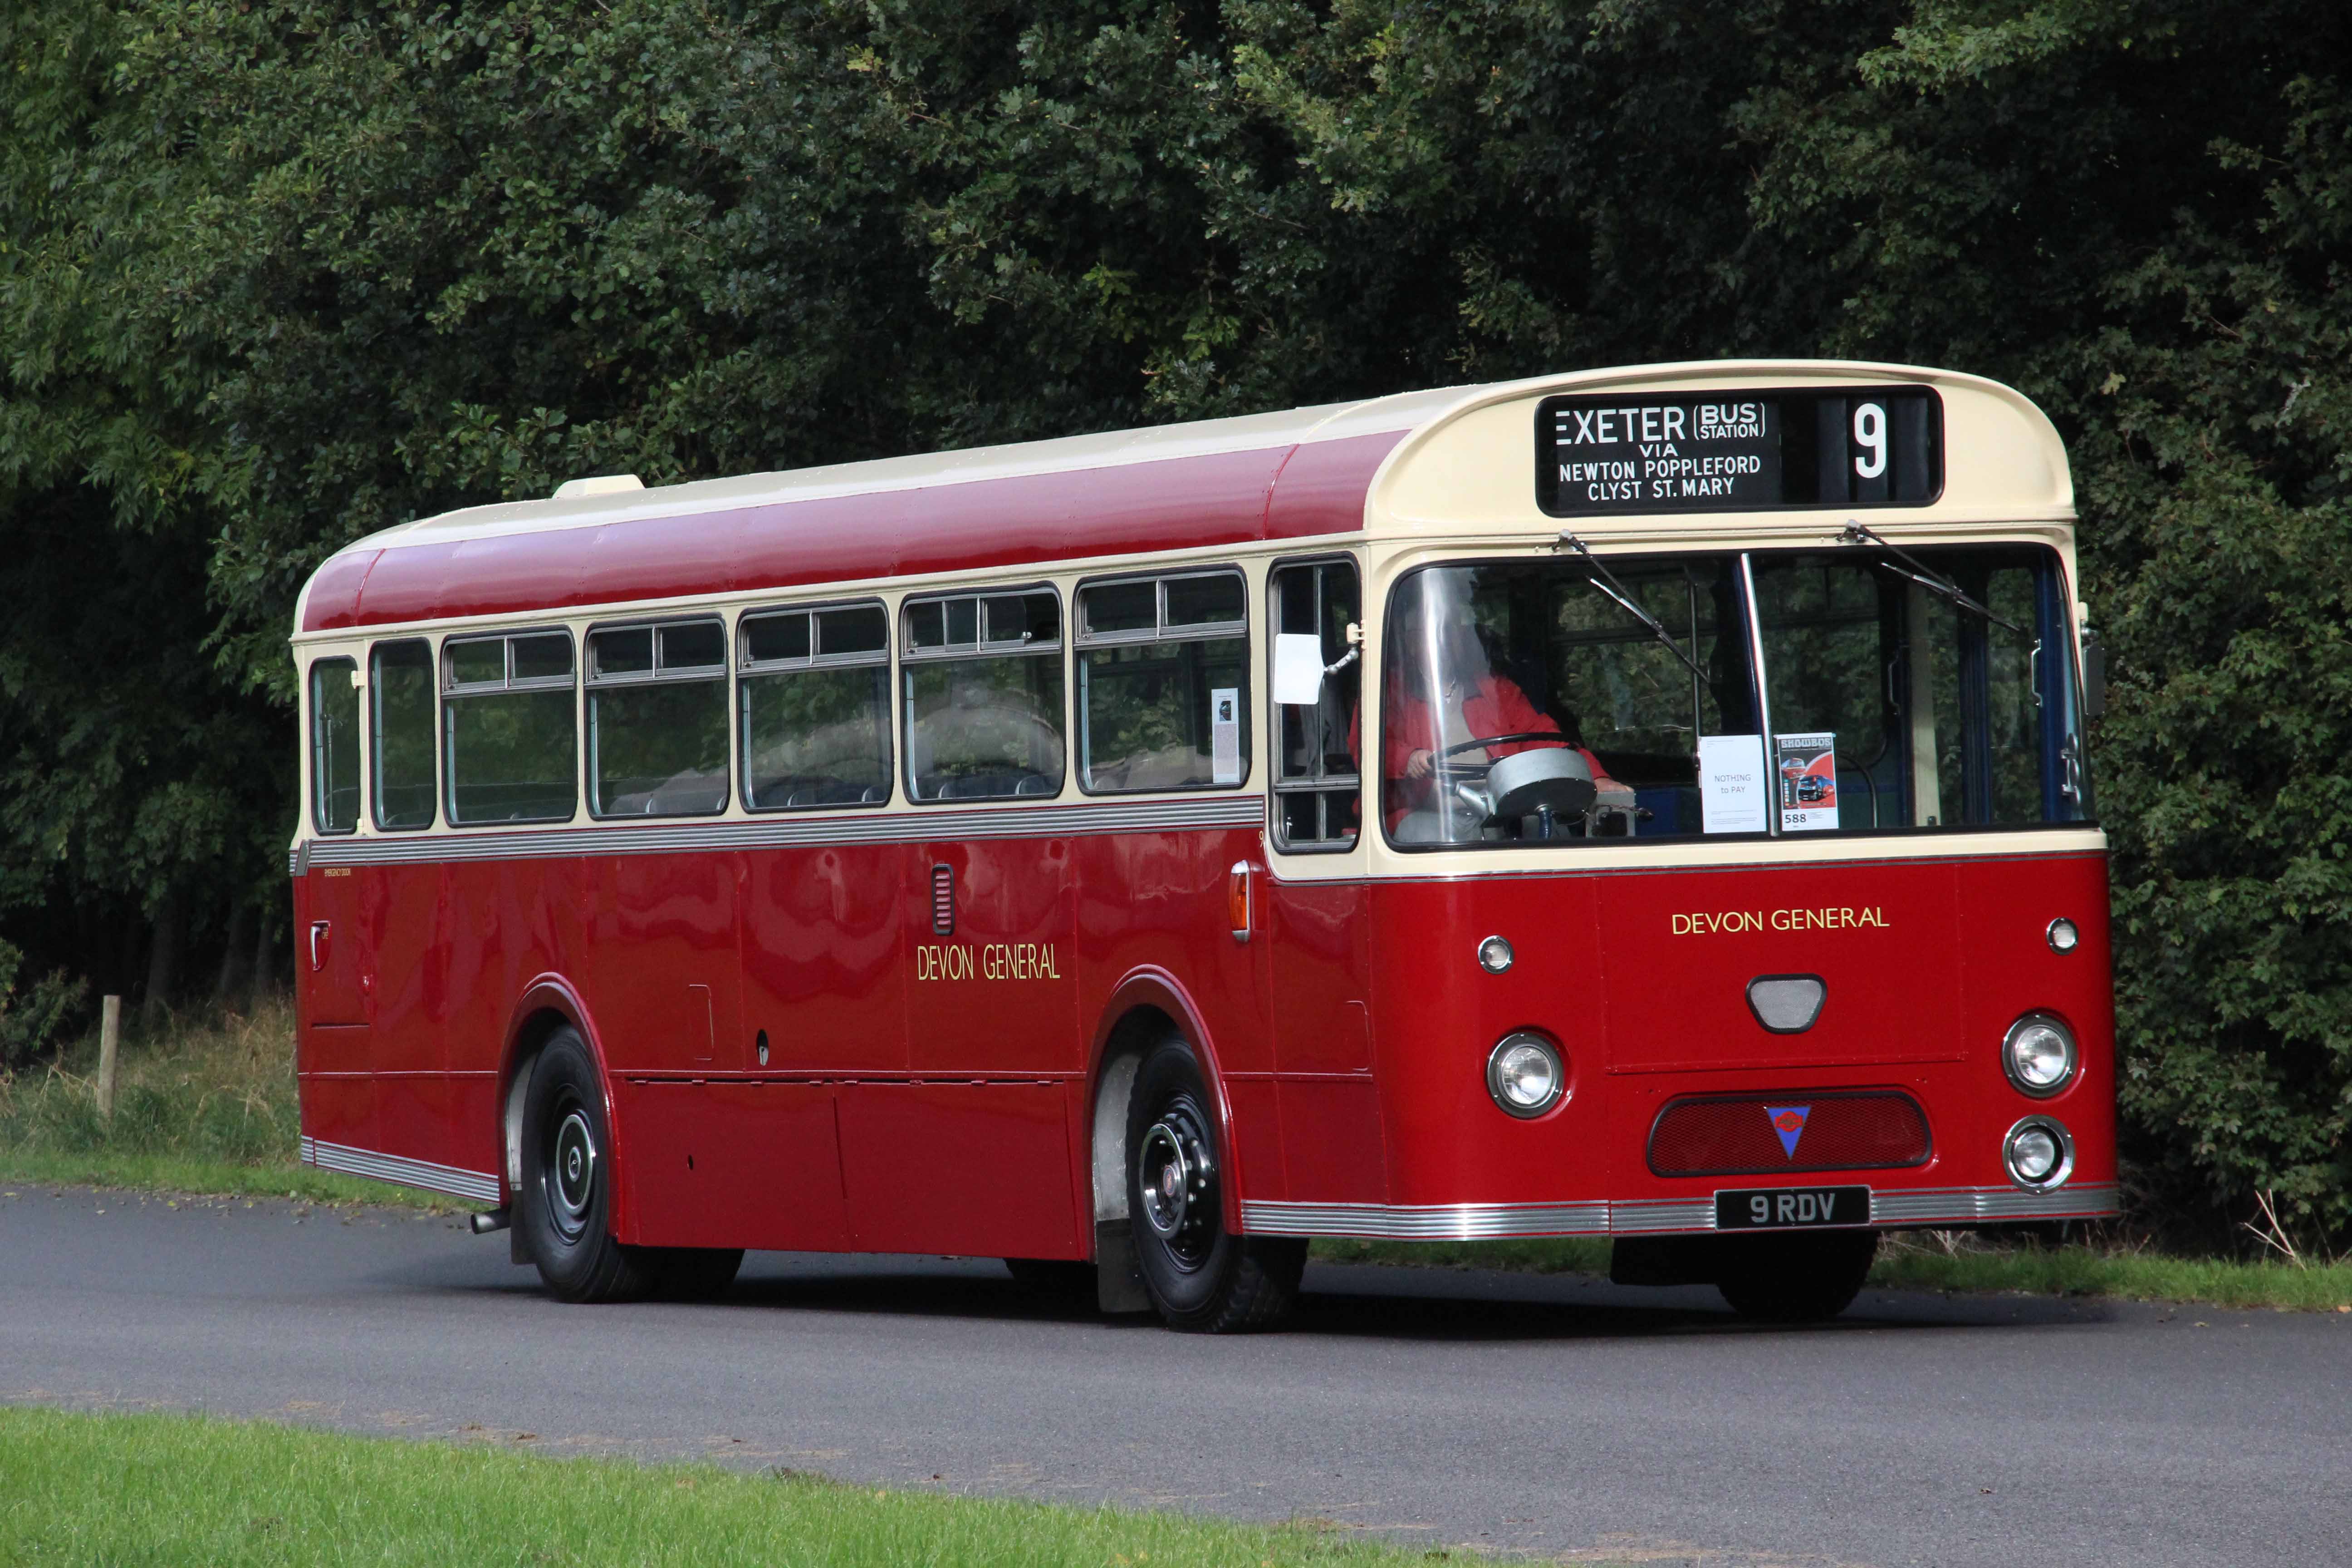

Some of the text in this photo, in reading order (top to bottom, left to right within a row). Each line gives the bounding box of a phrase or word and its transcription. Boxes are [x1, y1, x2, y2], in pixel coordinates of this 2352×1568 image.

[1555, 407, 1686, 445] EXETER
[1638, 443, 1678, 458] VIA
[1854, 403, 1886, 479] 9
[1559, 456, 1760, 482] NEWTON POPPLEFORD
[1588, 477, 1734, 501] CLYST ST. MARY
[1714, 774, 1751, 783] NOTHING
[1785, 813, 1807, 823] 588
[1672, 907, 1891, 935] DEVON GENERAL
[917, 943, 1061, 980] DEVON GENERAL
[1750, 1193, 1836, 1223] 9 RDV
